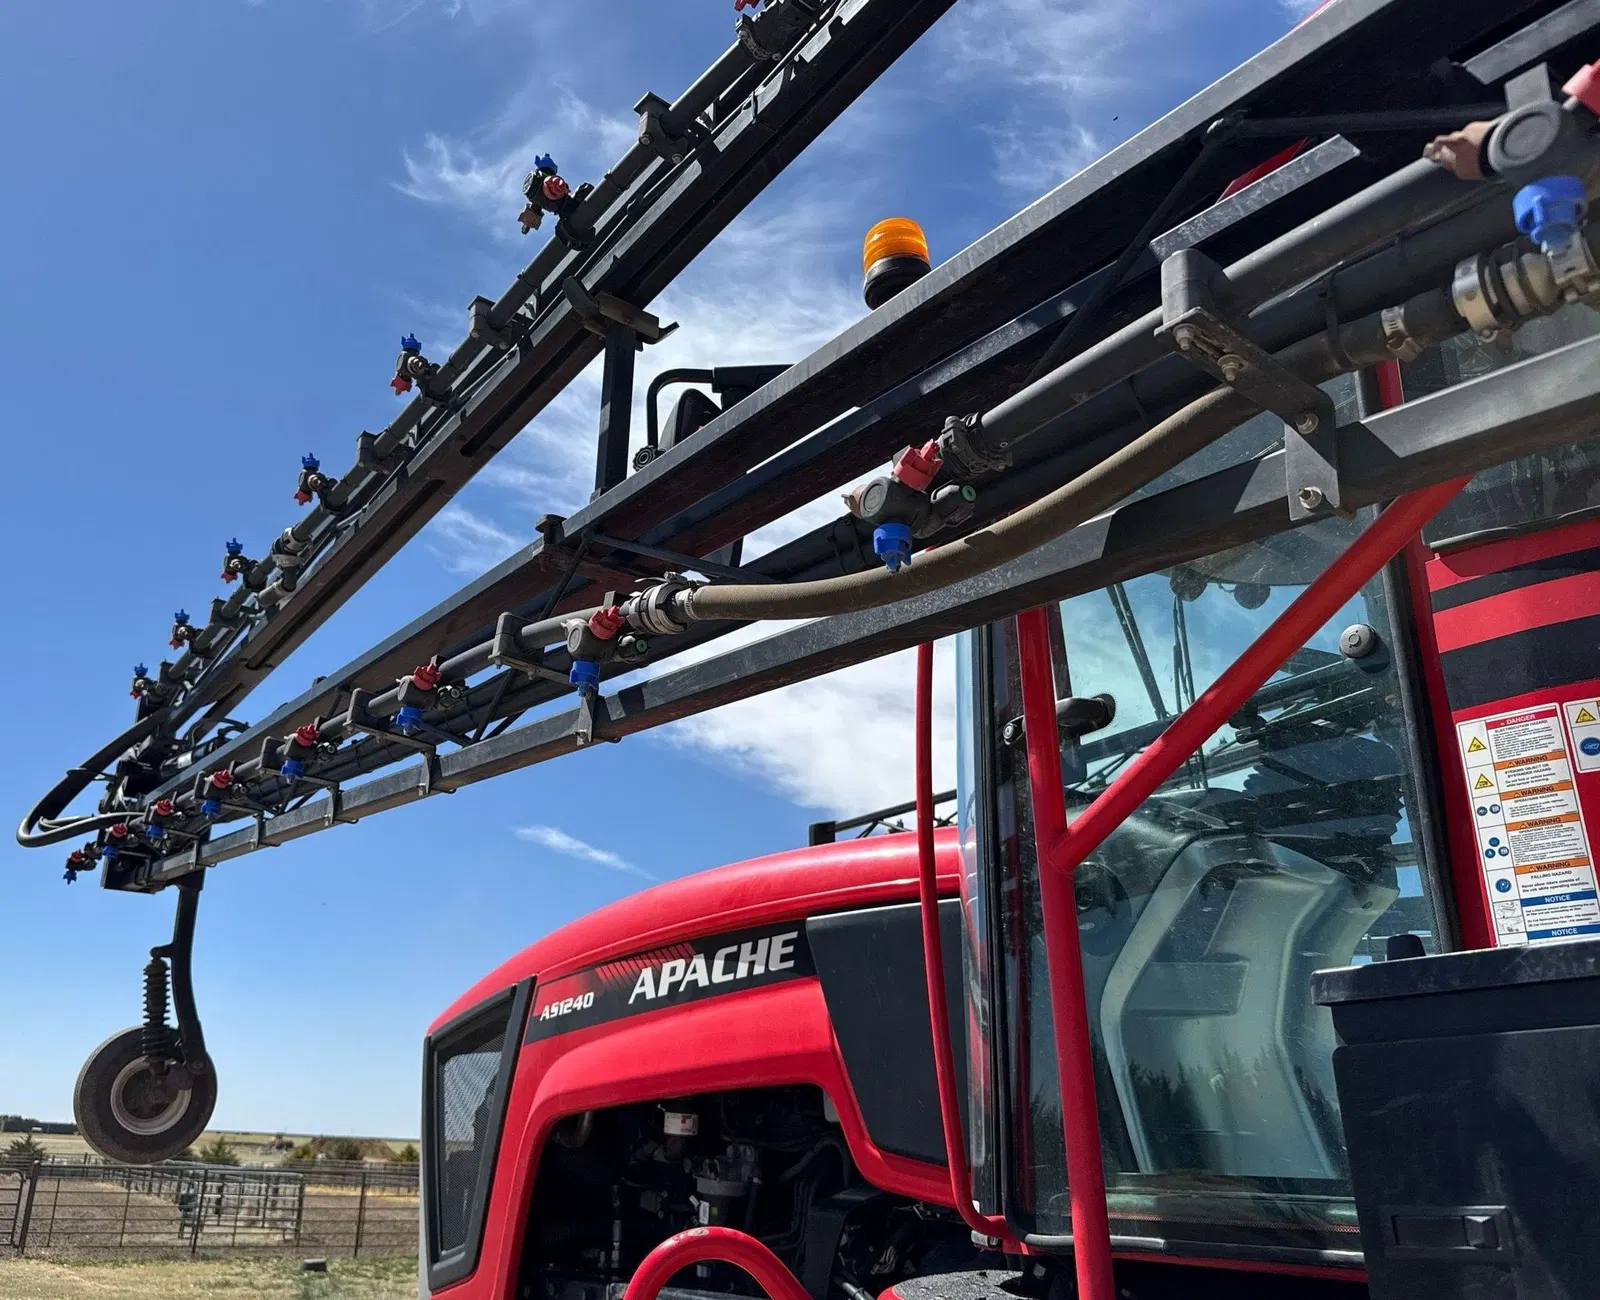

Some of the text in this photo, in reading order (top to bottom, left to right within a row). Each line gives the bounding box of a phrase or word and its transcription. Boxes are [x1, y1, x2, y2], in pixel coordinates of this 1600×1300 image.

[1506, 714, 1535, 724] DANGER
[1515, 755, 1548, 765] WARNING
[1520, 786, 1554, 796] WARNING
[1527, 817, 1561, 827] WARNING
[1536, 861, 1570, 871] WARNING
[1545, 894, 1571, 903] NOTICE
[1551, 928, 1578, 936] NOTICE
[628, 930, 798, 1005] APACHE
[540, 991, 594, 1022] AS1240
